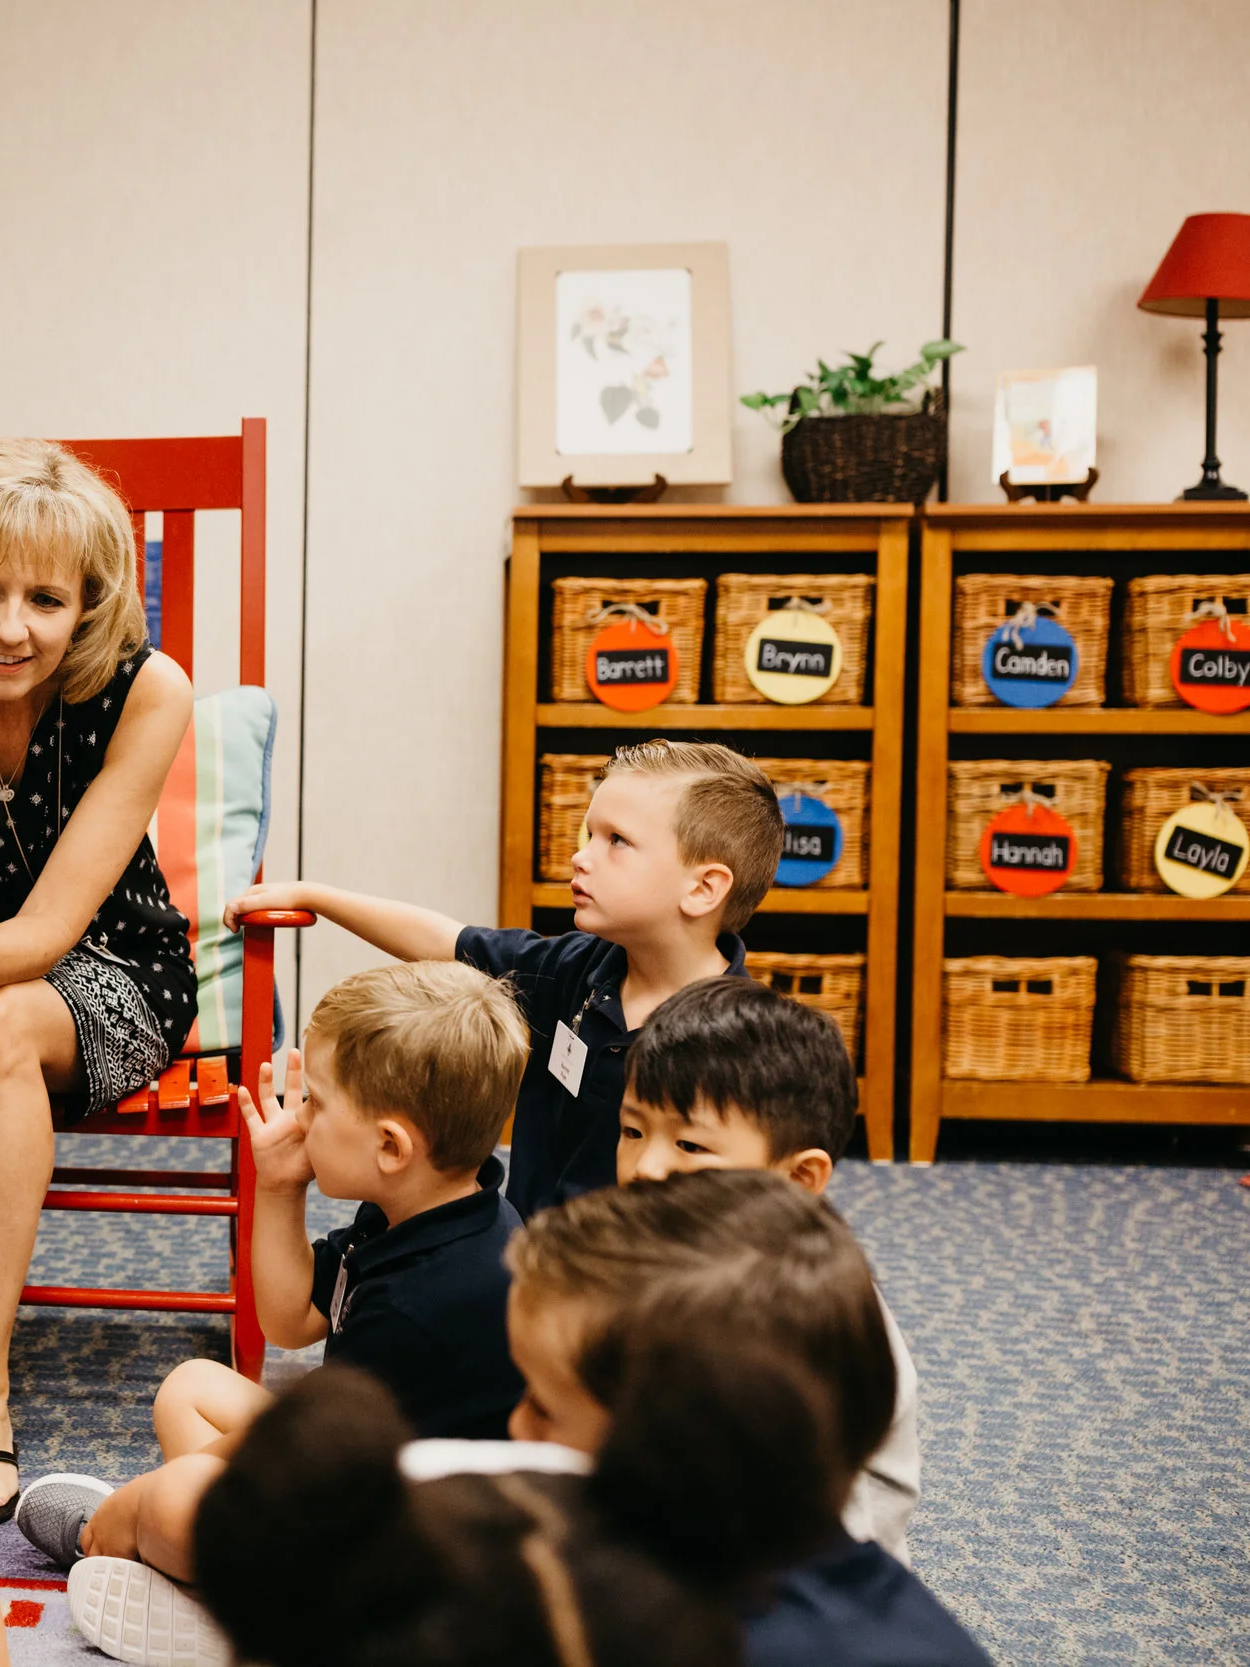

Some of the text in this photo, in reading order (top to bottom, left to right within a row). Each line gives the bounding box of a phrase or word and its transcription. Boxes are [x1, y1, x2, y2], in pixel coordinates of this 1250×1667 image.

[597, 655, 665, 682] Barrett
[761, 643, 826, 675] Brynn
[994, 646, 1070, 678] Camden
[1188, 652, 1250, 687] Colby
[783, 830, 822, 857] lisa
[991, 837, 1065, 868] Hannah
[1172, 833, 1231, 873] Layla
